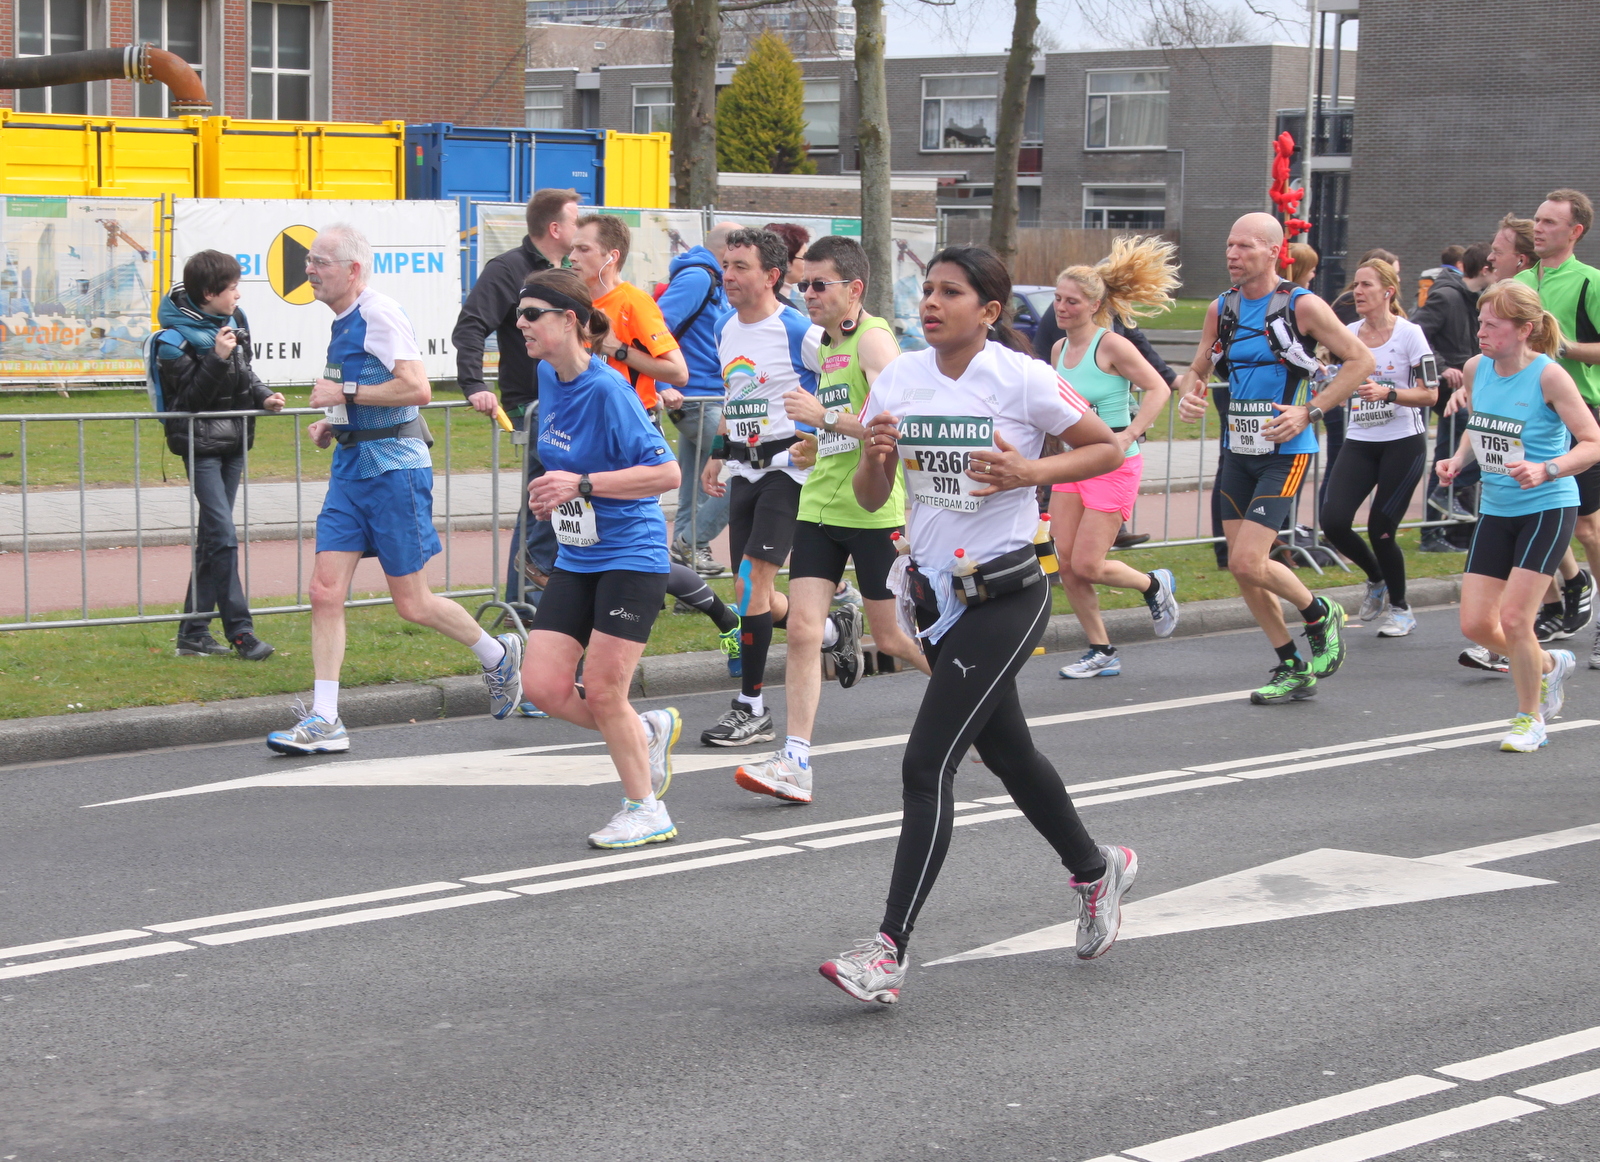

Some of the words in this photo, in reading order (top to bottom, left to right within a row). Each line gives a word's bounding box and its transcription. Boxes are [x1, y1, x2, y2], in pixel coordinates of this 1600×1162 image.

[15, 322, 86, 346] water
[0, 361, 20, 371] WE
[25, 361, 54, 371] HART
[56, 360, 80, 371] VAN
[824, 388, 848, 404] AMRO
[723, 404, 738, 416] ABN
[739, 403, 767, 414] AMRO
[1243, 402, 1272, 412] AMRO
[1353, 409, 1394, 422] JACQUELINE
[736, 420, 761, 437] 1915
[900, 422, 933, 438] ABN
[938, 423, 990, 439] AMRO
[1235, 418, 1259, 433] 3519
[1468, 415, 1489, 428] ABN
[1491, 420, 1523, 434] AMRO
[1240, 435, 1254, 445] COR
[1481, 435, 1510, 452] F765
[1485, 452, 1503, 465] ANN
[932, 476, 960, 495] SITA
[556, 500, 583, 518] 504
[915, 493, 962, 509] ROTTERDAM
[964, 501, 981, 510] 201
[555, 533, 580, 544] TERDAM
